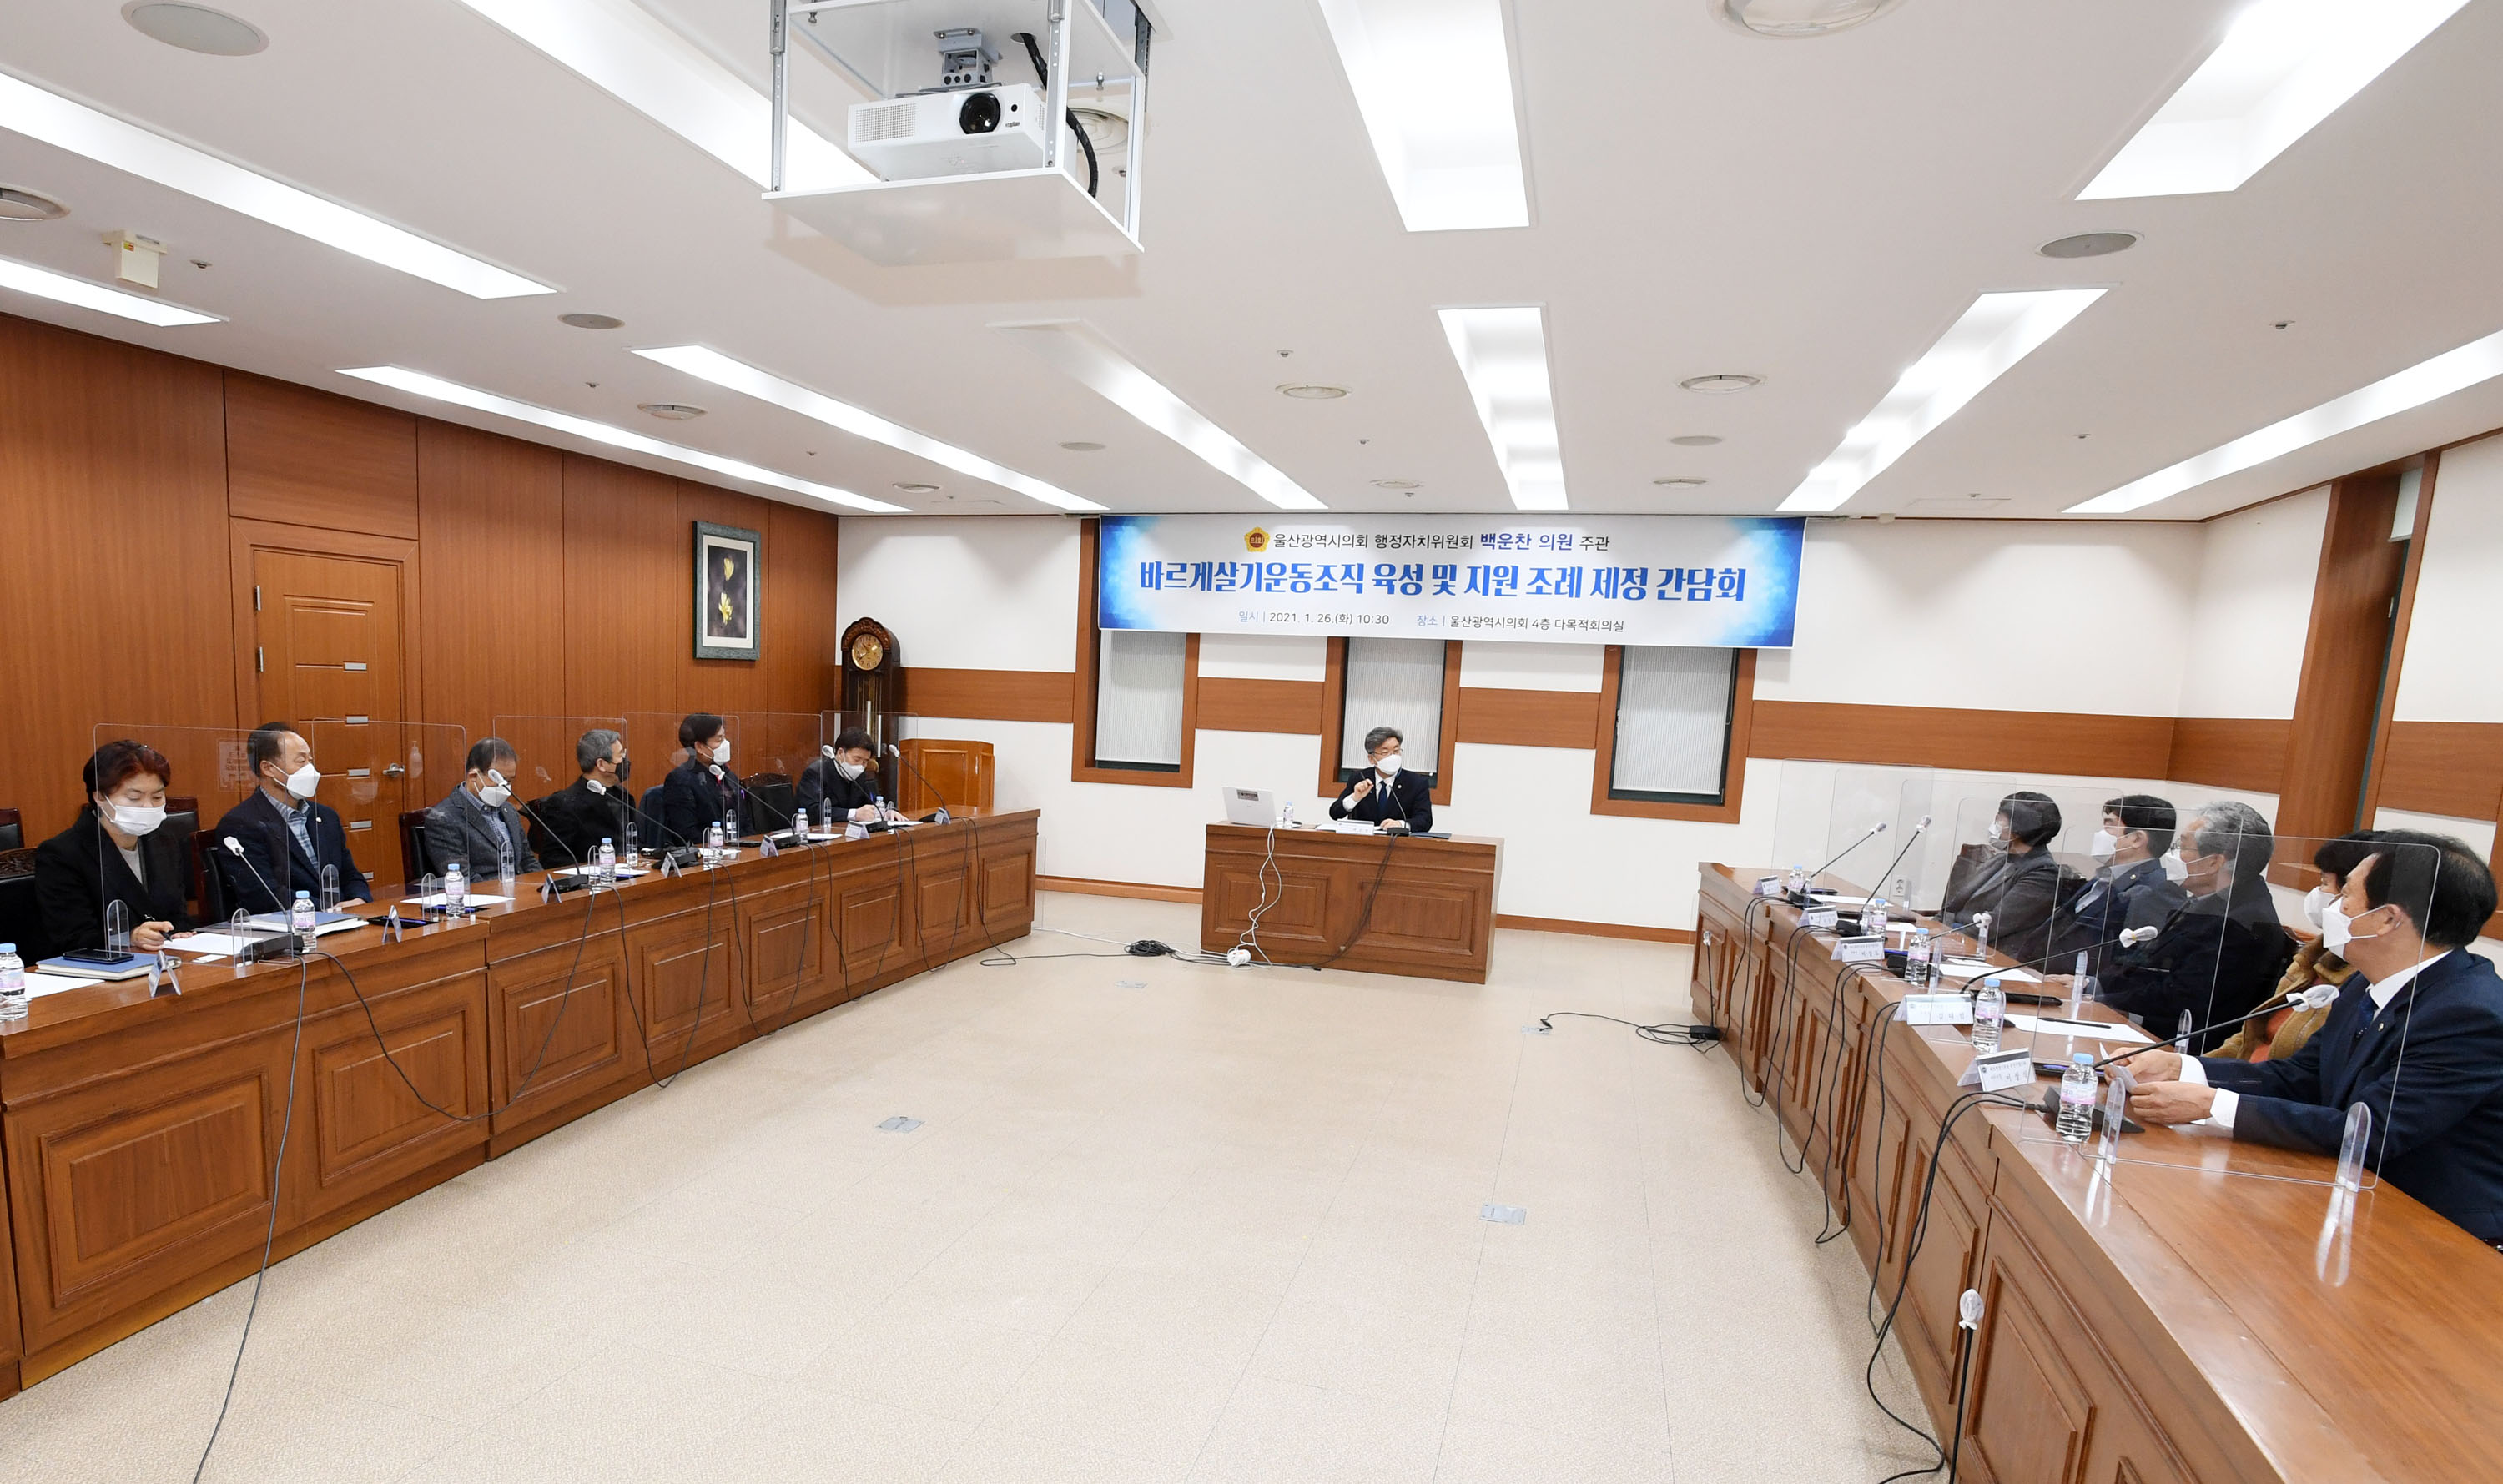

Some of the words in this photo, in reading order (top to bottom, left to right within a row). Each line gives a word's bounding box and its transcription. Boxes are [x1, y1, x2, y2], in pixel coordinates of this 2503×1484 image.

[1274, 533, 1367, 549] 울산광역시의회
[1375, 534, 1473, 550] 행정자치위원회
[1481, 533, 1532, 551] 백운찬
[1539, 534, 1573, 551] 의원
[1579, 536, 1610, 551] 주관
[1141, 561, 1364, 594] 바르게살기운동조직
[1372, 564, 1423, 596] 육성
[1432, 564, 1457, 596] 및
[1464, 565, 1518, 596] 지원
[1526, 566, 1583, 598] 조례
[1590, 567, 1649, 601] 제정
[1656, 568, 1747, 601] 간담회
[1239, 611, 1259, 622] 일시
[1269, 612, 1301, 623] 2021.
[1304, 613, 1314, 623] 1.
[1317, 613, 1353, 626] 26.(화)
[1357, 614, 1390, 625] 10:30
[1417, 615, 1438, 627] 장소
[1449, 616, 1528, 630] 울산광역시의회
[1532, 618, 1551, 631] 4층
[1554, 619, 1624, 632] 다목적회의실
